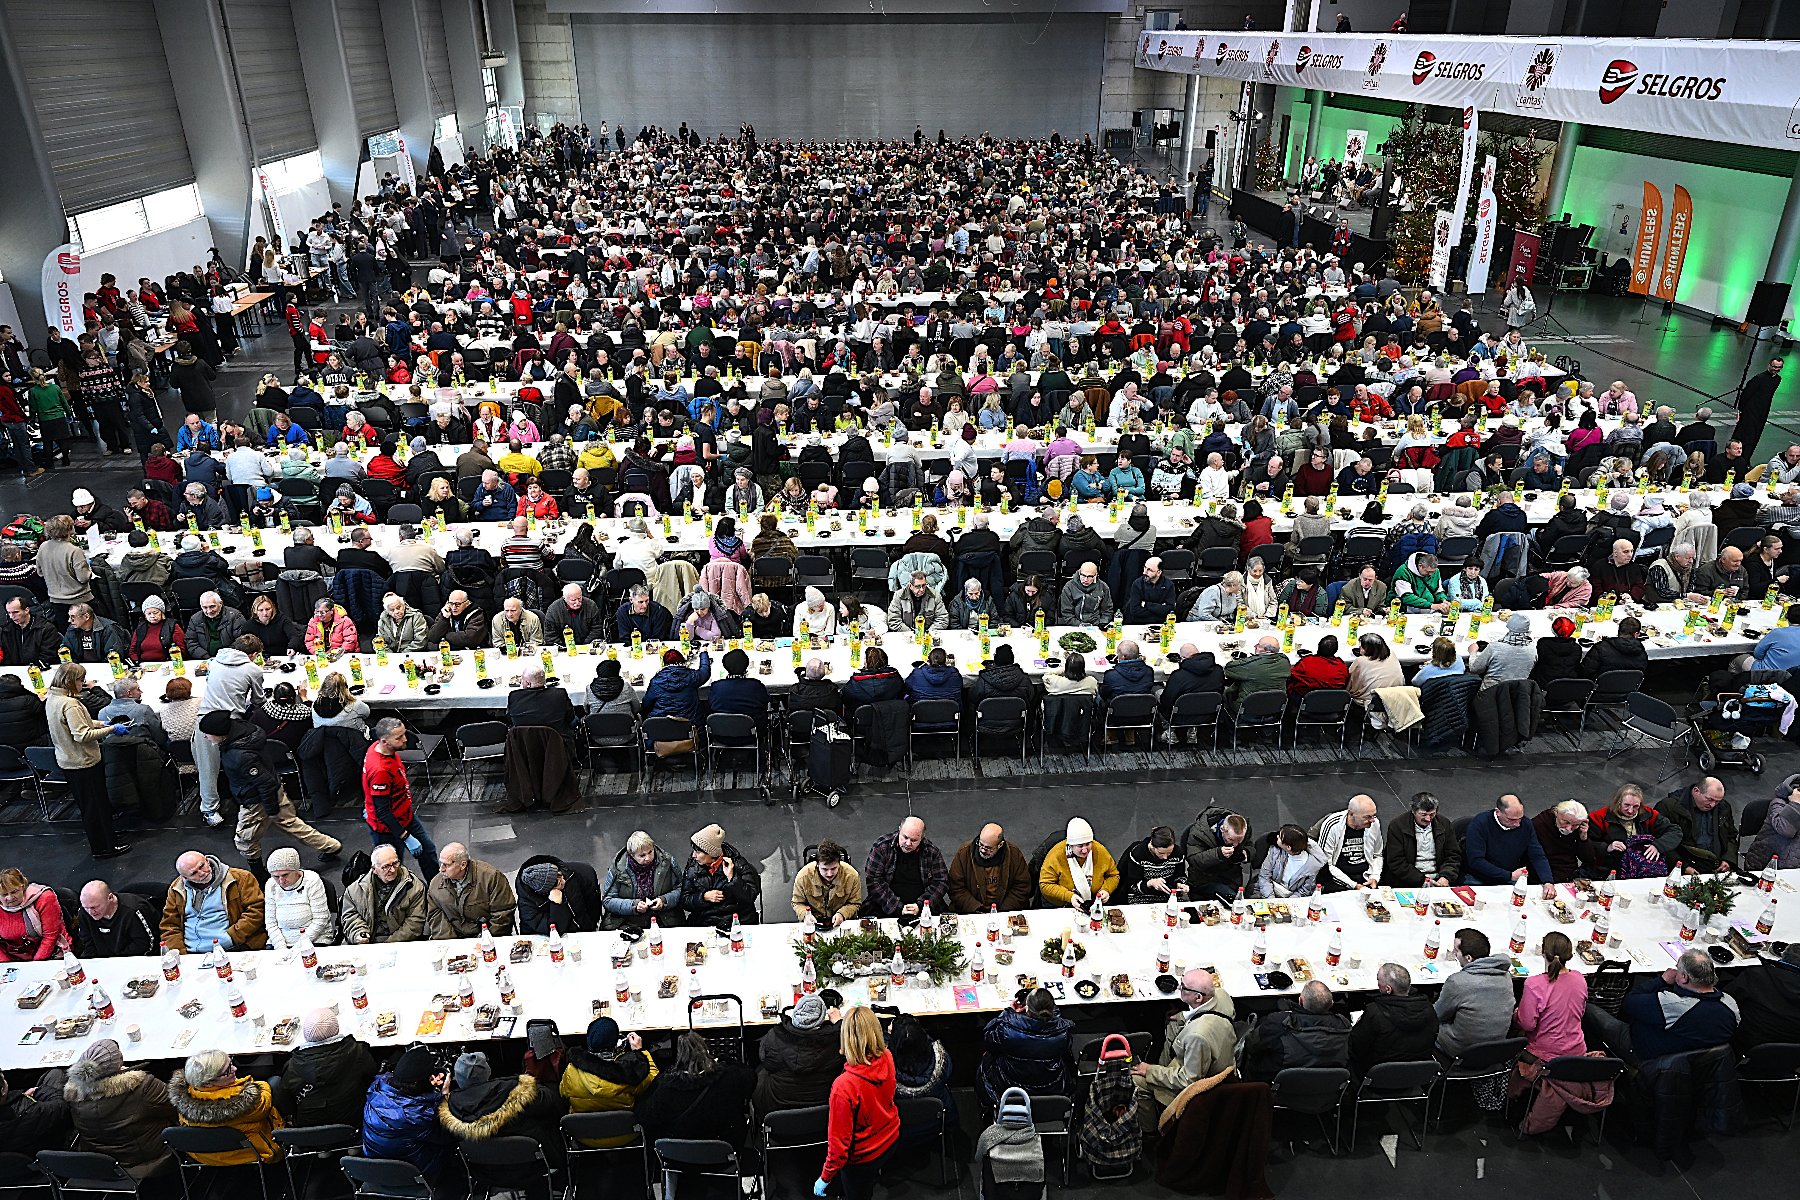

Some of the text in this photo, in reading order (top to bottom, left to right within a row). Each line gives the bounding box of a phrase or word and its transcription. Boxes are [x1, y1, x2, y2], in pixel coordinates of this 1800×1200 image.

[1310, 54, 1344, 69] SELGROS
[1435, 62, 1486, 81] SELGROS
[1636, 73, 1727, 101] SELGROS
[1519, 94, 1542, 106] caritas
[57, 281, 75, 332] SELGROS
